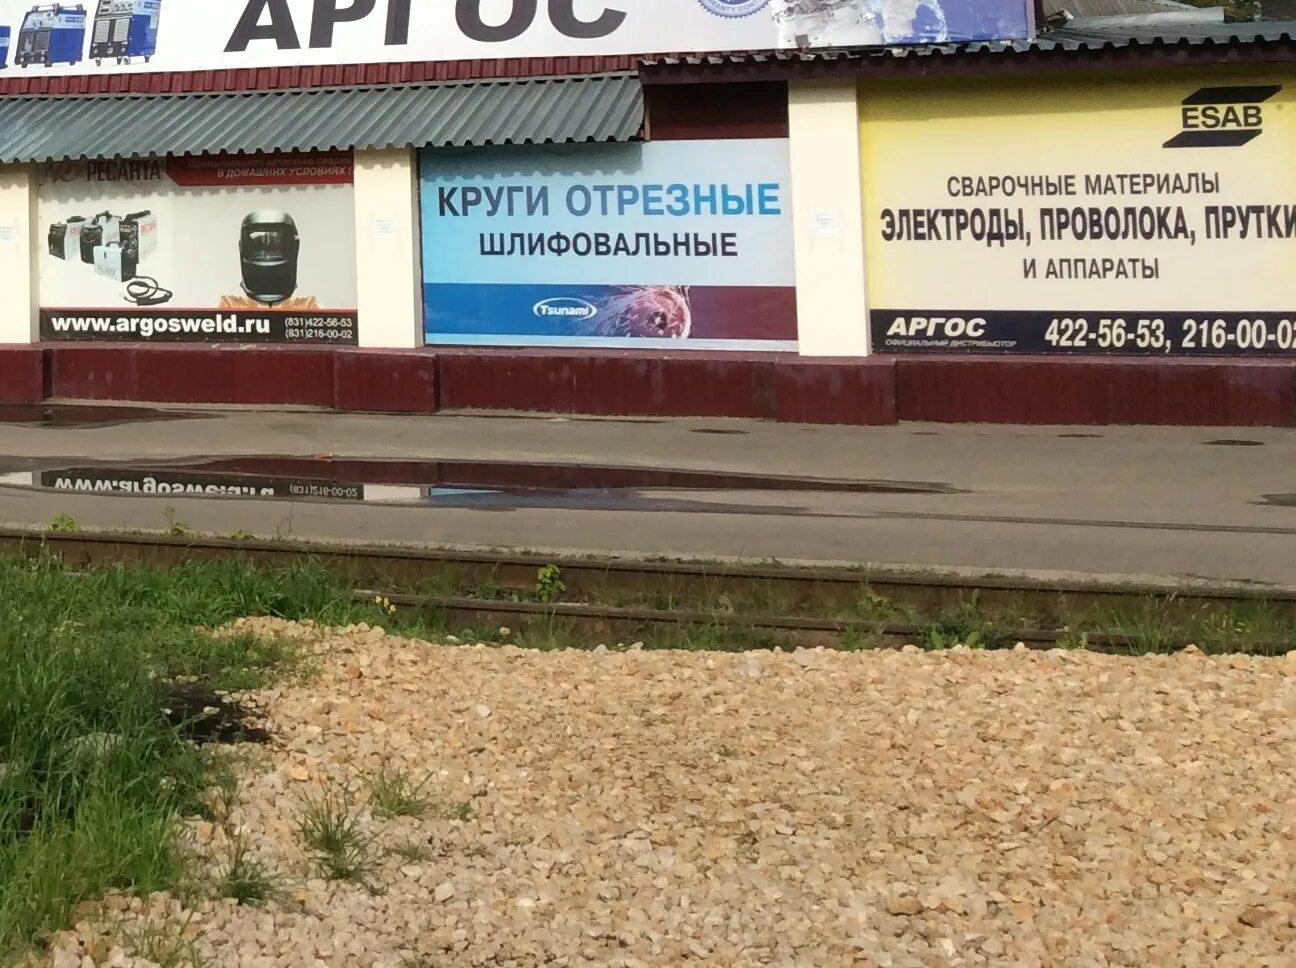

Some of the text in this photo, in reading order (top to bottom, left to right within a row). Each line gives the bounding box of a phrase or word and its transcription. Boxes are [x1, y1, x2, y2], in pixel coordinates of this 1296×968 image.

[1181, 104, 1263, 129] ESAB
[225, 167, 286, 179] ДОМАШНИХ
[289, 166, 346, 176] УСЛОВИЯХ
[946, 172, 1220, 197] СВАРОЧНЫЕ МАТЕРИАЛЫ
[438, 183, 782, 217] КРУГИ ОТРЕЗНЫЕ
[880, 204, 1296, 248] ЭЛЕКТРОДЫ, ПРОВОЛОКА, ПРУТКИ
[479, 231, 739, 257] ШЛИФОВАЛЬНЫЕ
[1022, 257, 1160, 280] И АППАРАТЫ
[539, 303, 590, 317] Tsunami
[51, 314, 353, 337] www.argosweld.ru (831)422-56-53
[284, 328, 353, 339] (831)216-00-02
[886, 316, 988, 337] АРГОС
[1044, 318, 1296, 353] 422-56-53, 216-00-0
